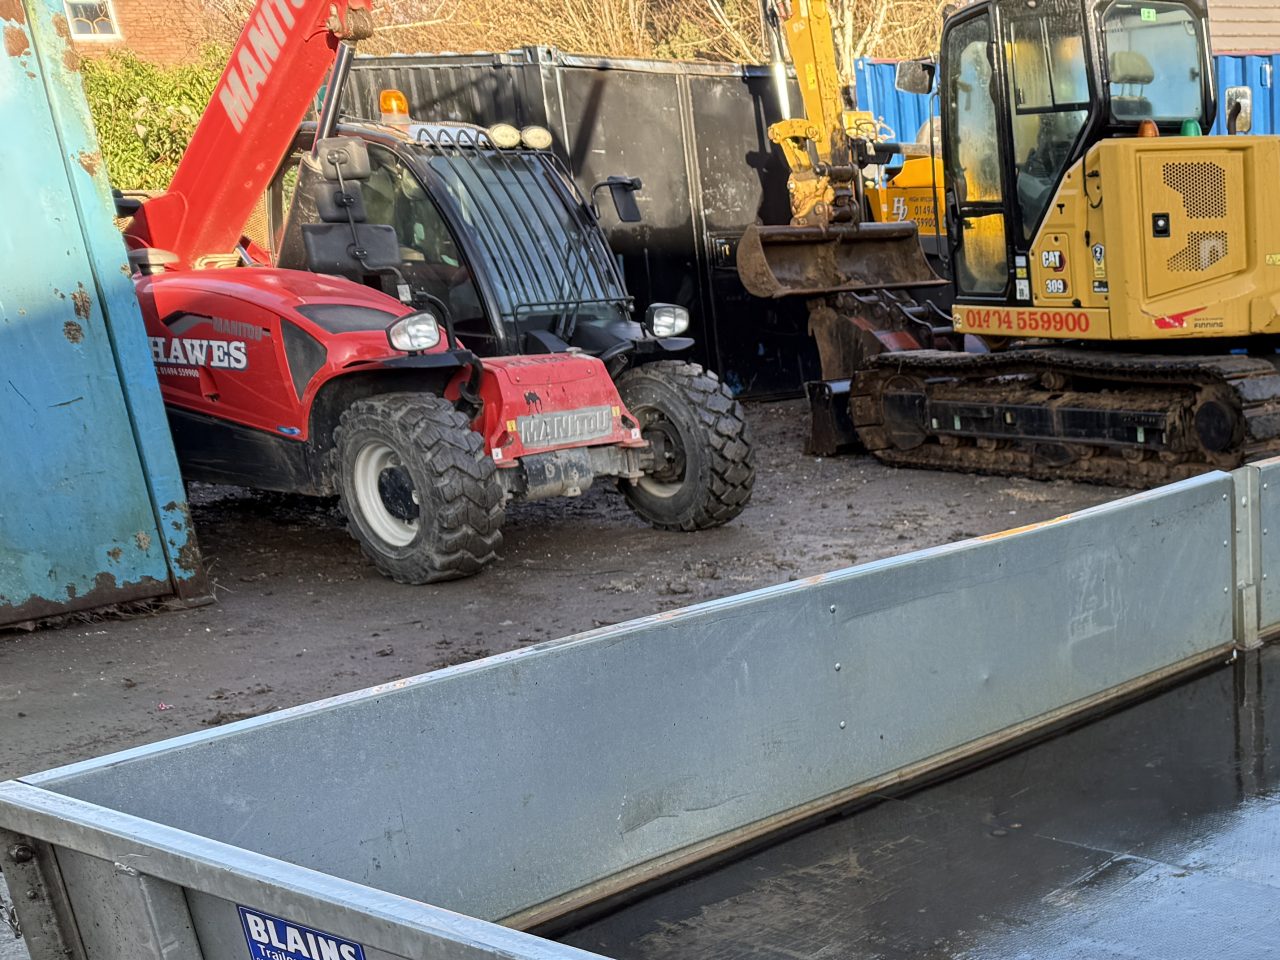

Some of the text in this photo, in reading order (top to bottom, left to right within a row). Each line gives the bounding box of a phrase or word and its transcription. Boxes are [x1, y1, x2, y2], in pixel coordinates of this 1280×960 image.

[1042, 250, 1061, 268] CAT
[1045, 279, 1064, 293] 309
[212, 315, 263, 341] MANITOU
[1017, 310, 1090, 333] 559900
[148, 336, 248, 370] HAWES
[521, 410, 610, 444] MANITOU
